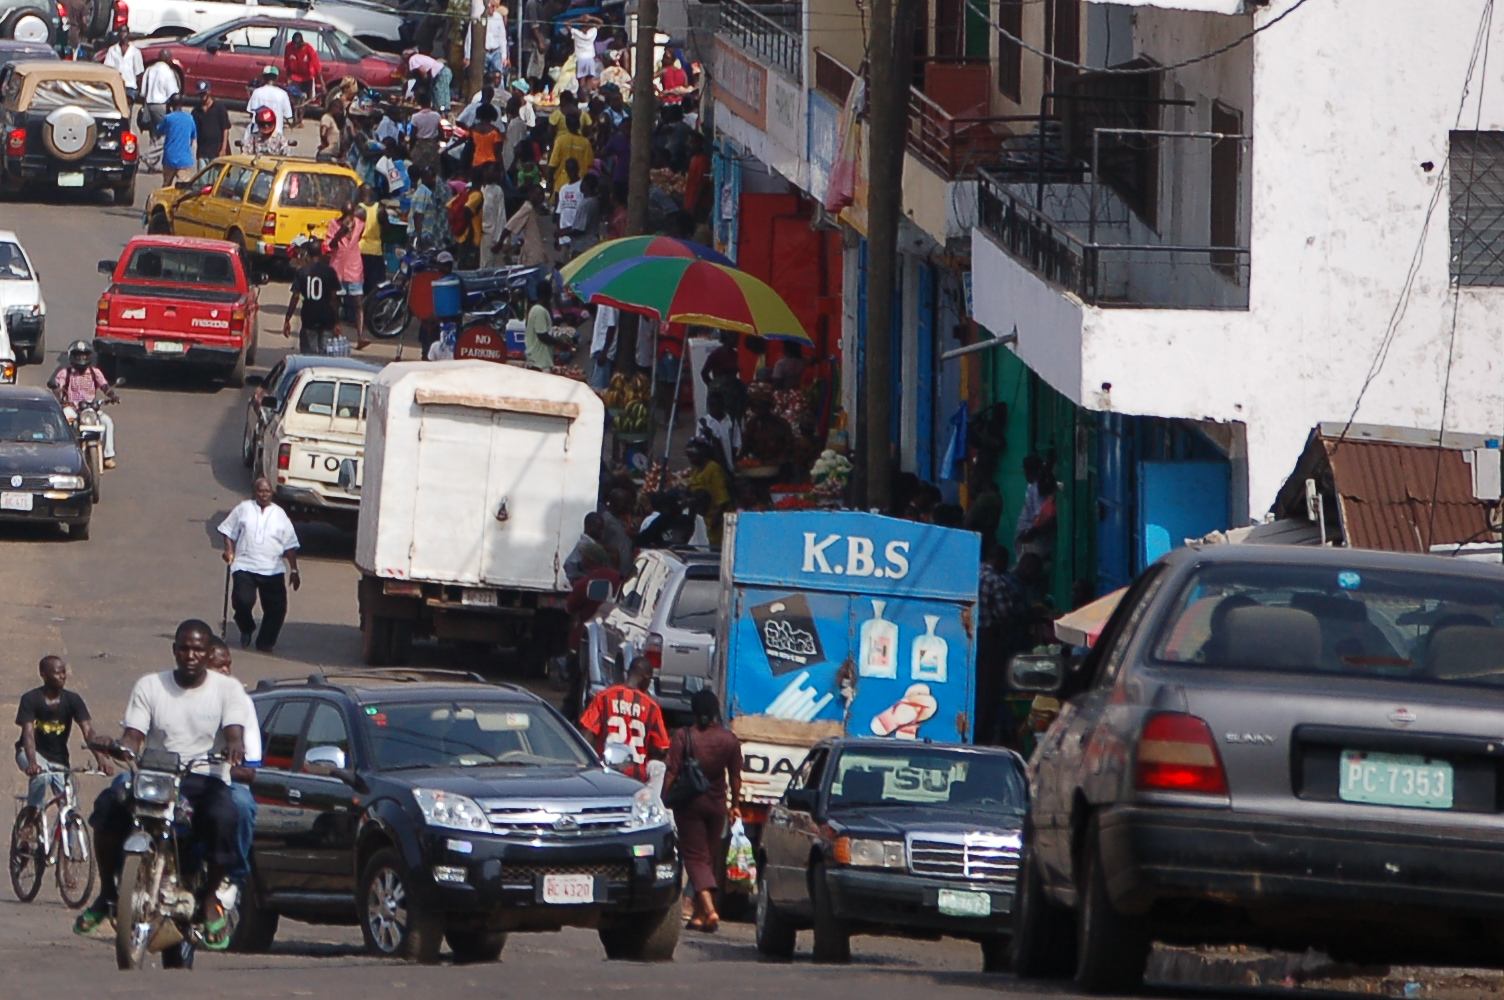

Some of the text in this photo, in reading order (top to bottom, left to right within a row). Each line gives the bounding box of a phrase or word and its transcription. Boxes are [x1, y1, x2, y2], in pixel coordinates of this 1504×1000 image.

[306, 275, 323, 300] 10
[475, 334, 492, 345] NO
[460, 346, 502, 359] PARKING
[801, 532, 911, 579] K.B.S
[612, 699, 642, 718] KAKA
[606, 715, 646, 764] 22
[1225, 733, 1277, 746] SUNNY
[564, 882, 590, 897] 4320
